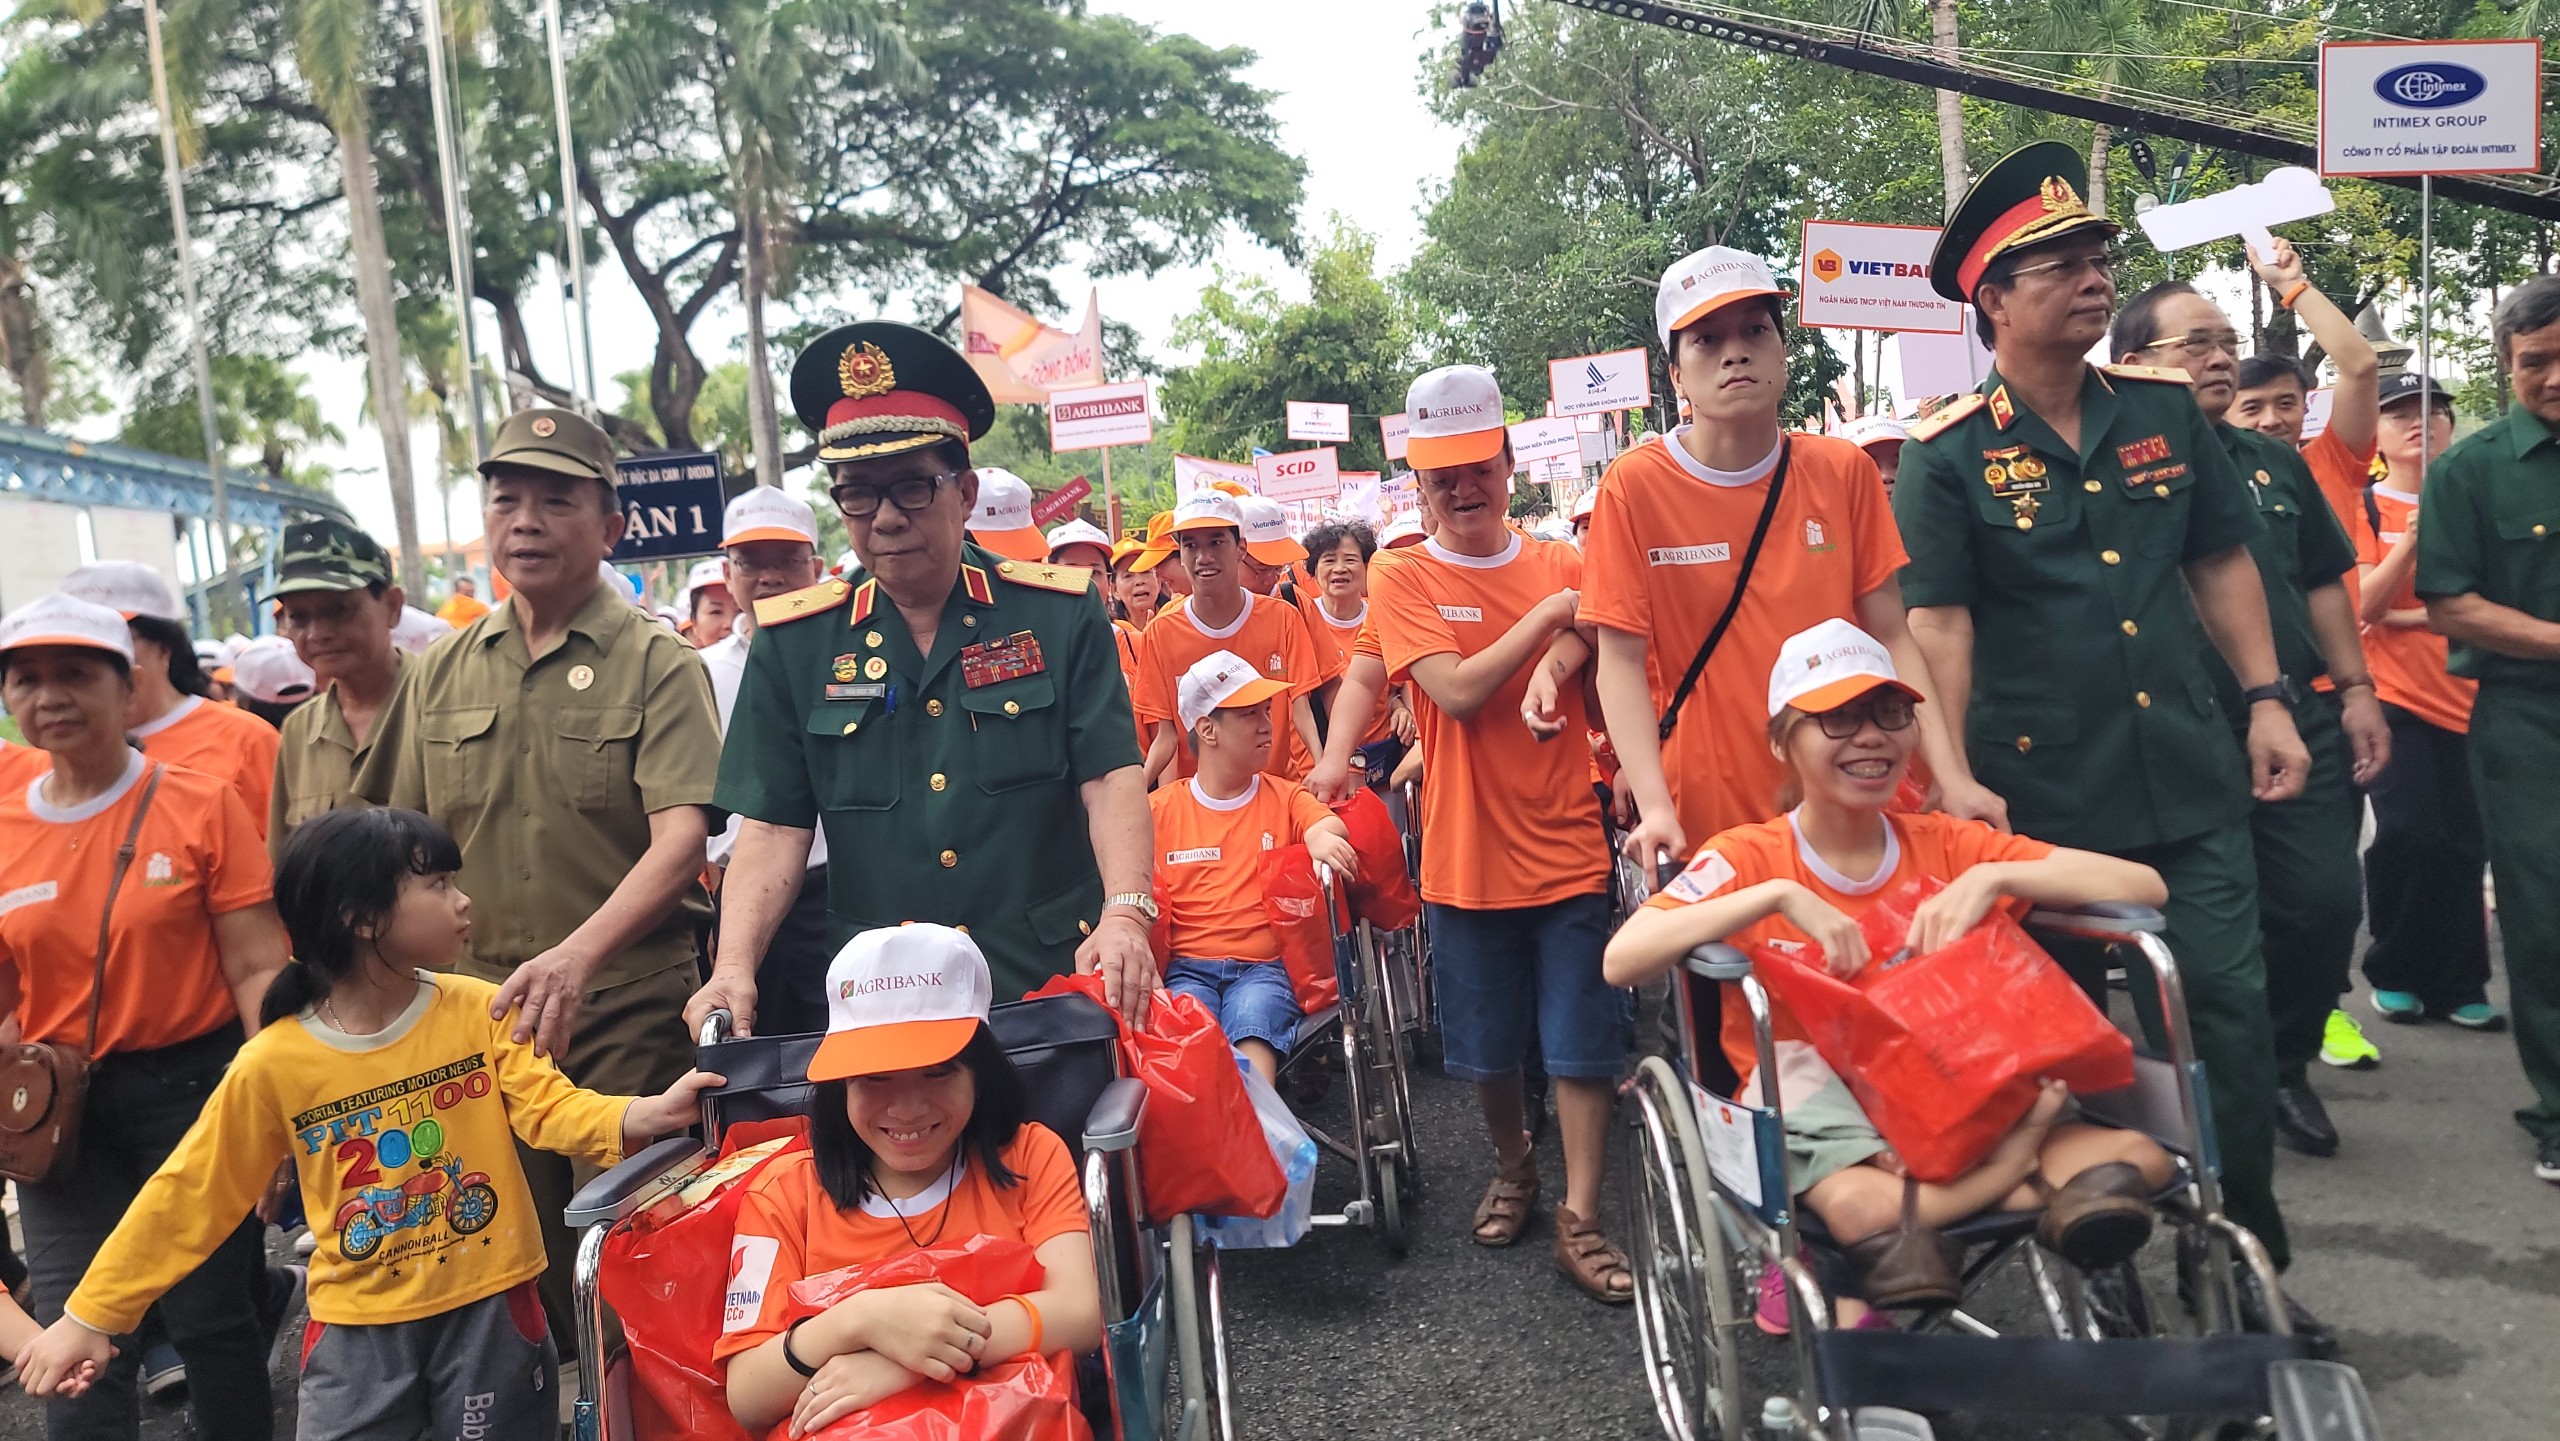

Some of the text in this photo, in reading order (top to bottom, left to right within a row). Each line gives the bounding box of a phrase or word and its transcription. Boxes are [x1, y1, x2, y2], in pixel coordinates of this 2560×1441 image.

[2423, 81, 2467, 92] Intimex
[2373, 115, 2487, 128] INTIMEX GROUP
[2343, 146, 2371, 157] CÔNG
[2374, 147, 2384, 156] TY
[2481, 144, 2517, 154] INTIMEX
[1819, 294, 1947, 310] NGÂN HÀNG TMCP VIỆT NAM THƯƠNG TÍN
[1072, 400, 1141, 419] AGRIBANK
[1430, 403, 1483, 419] AGRIBANK
[1276, 461, 1316, 477] SCID
[1380, 483, 1400, 494] Spa
[1045, 484, 1083, 514] AGRIBANK
[689, 504, 708, 534] 1
[1662, 547, 1726, 562] AGRIBANK
[856, 972, 943, 997] AGRIBANK
[300, 1056, 480, 1127] PORTAL FEATURING MOTOR NEWS
[297, 1071, 492, 1155] PIT 1100
[337, 1117, 444, 1190] 200
[383, 1201, 400, 1216] 20
[456, 1391, 495, 1441] Bab
